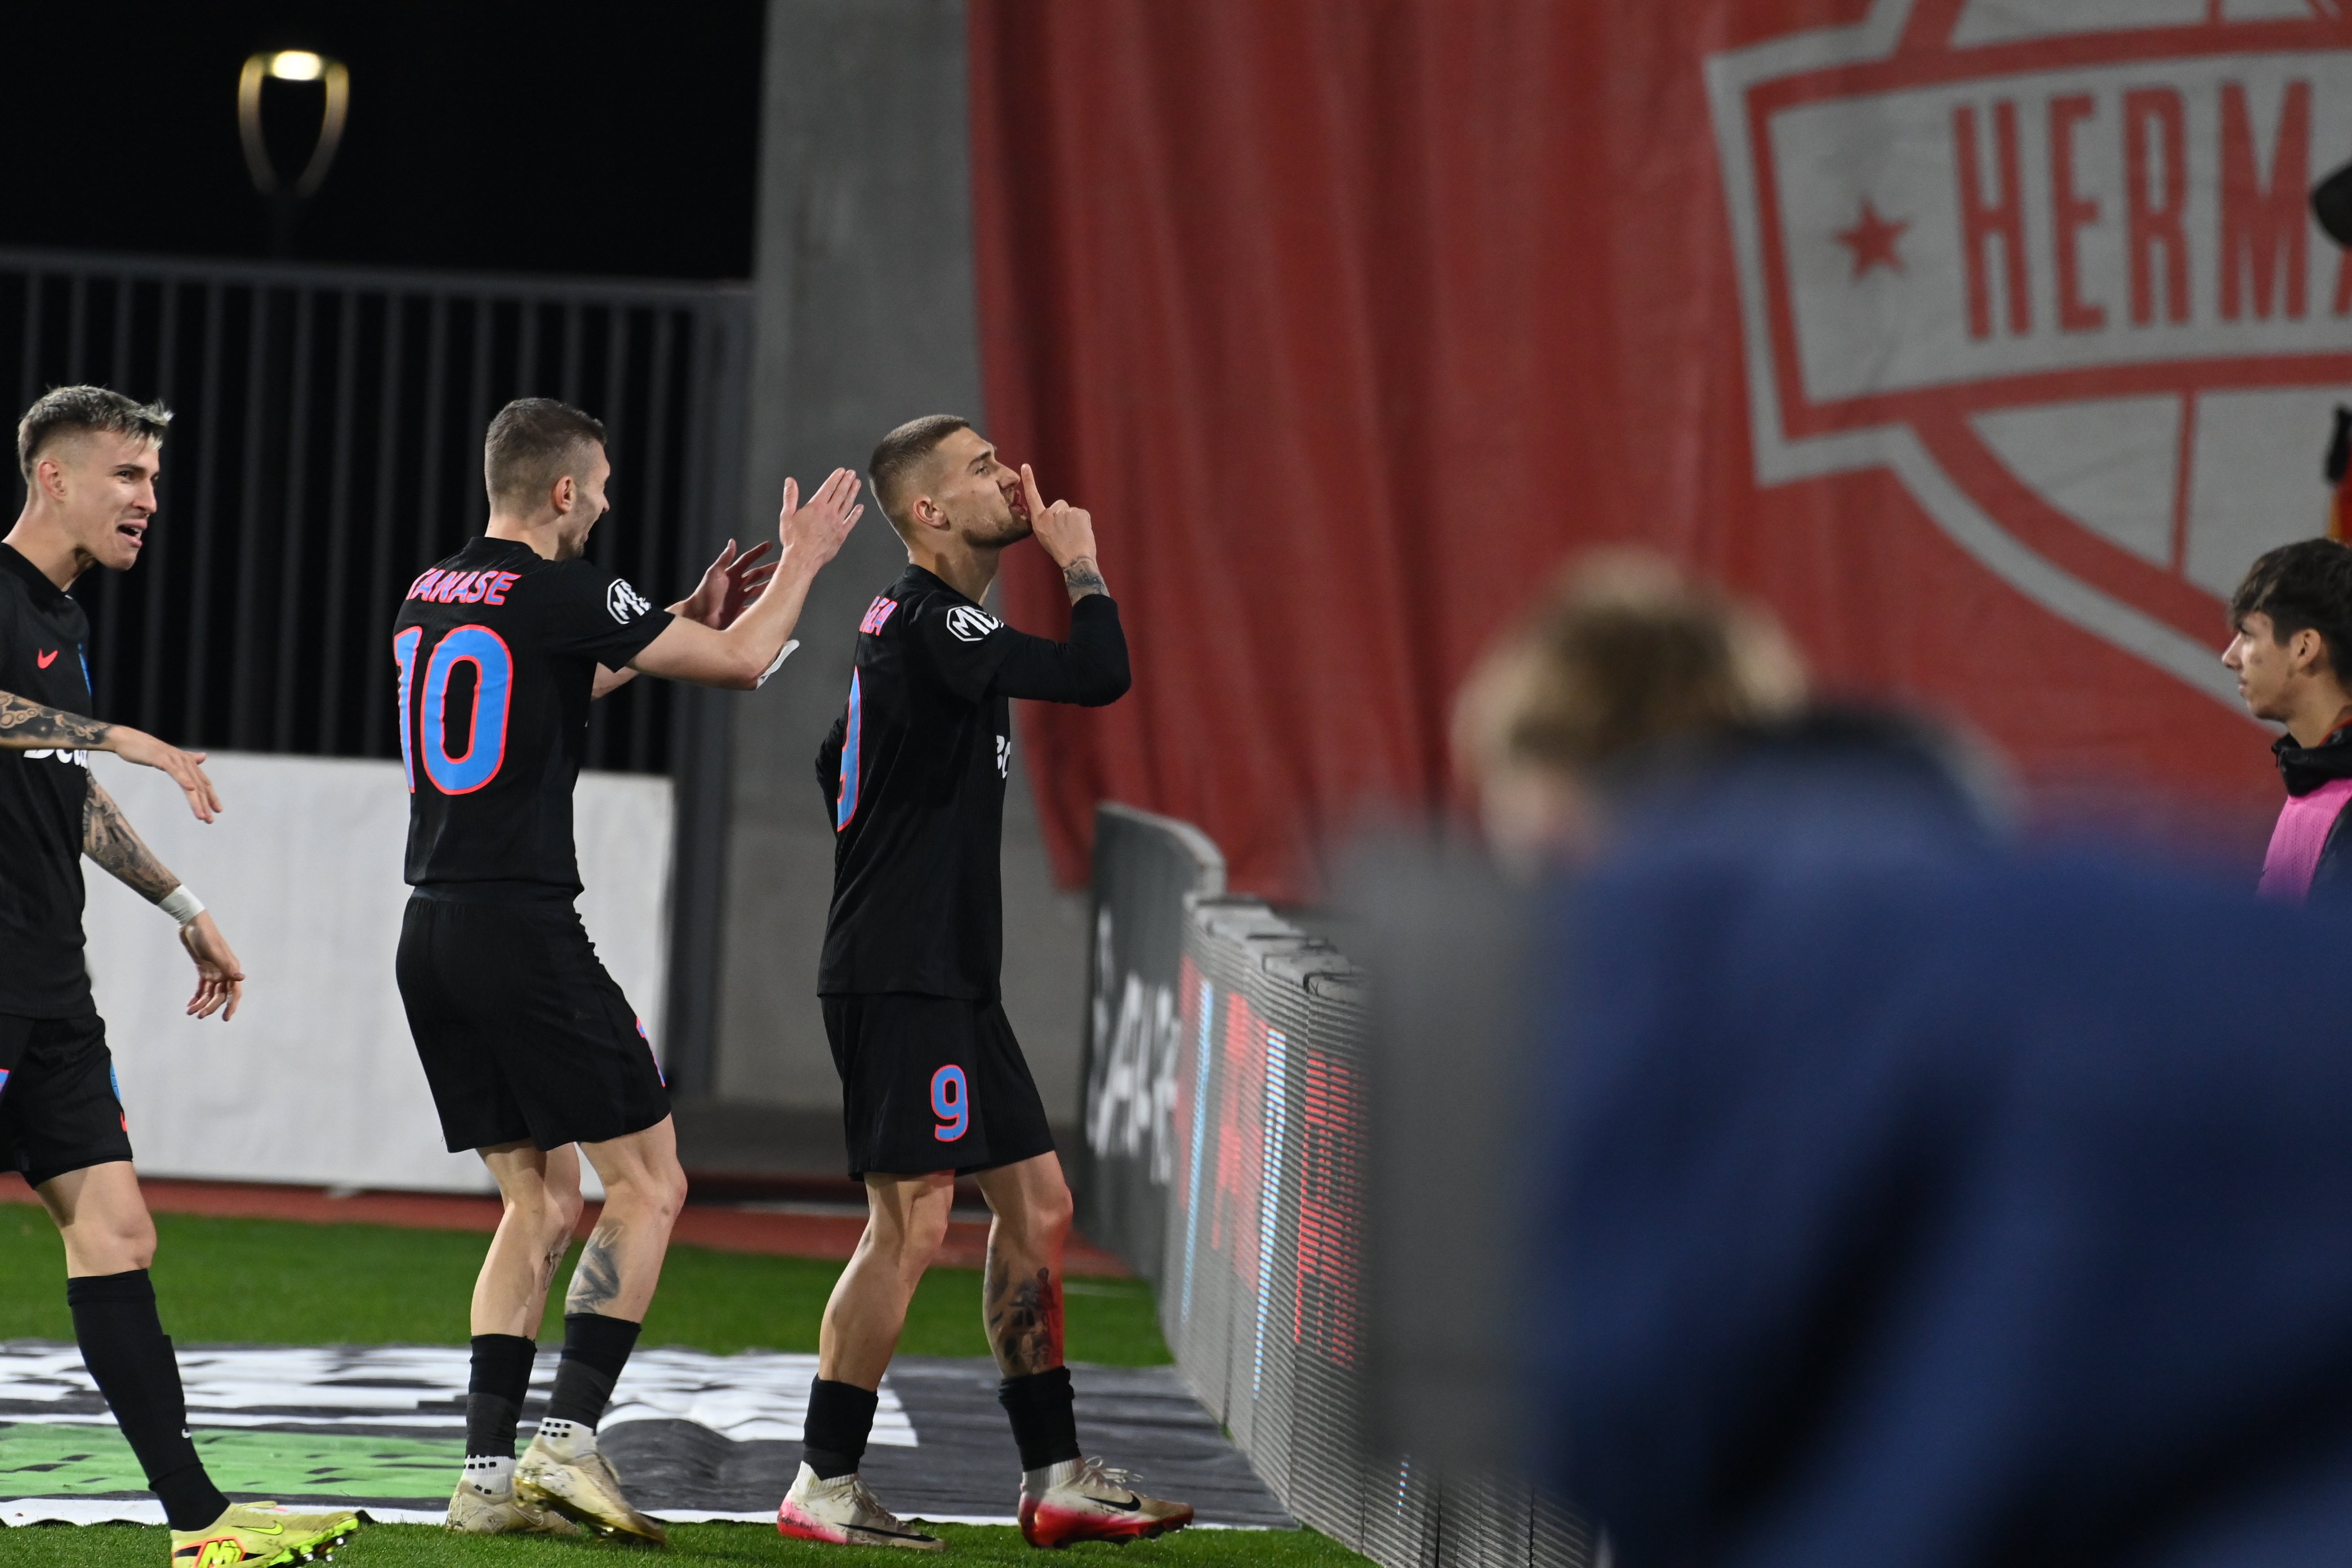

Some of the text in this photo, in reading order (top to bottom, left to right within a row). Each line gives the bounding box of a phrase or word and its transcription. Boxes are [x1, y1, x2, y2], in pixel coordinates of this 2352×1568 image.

[1952, 79, 2352, 341] HERM
[406, 568, 523, 605] TANASE
[394, 624, 513, 795] 10
[930, 1064, 969, 1142] 9
